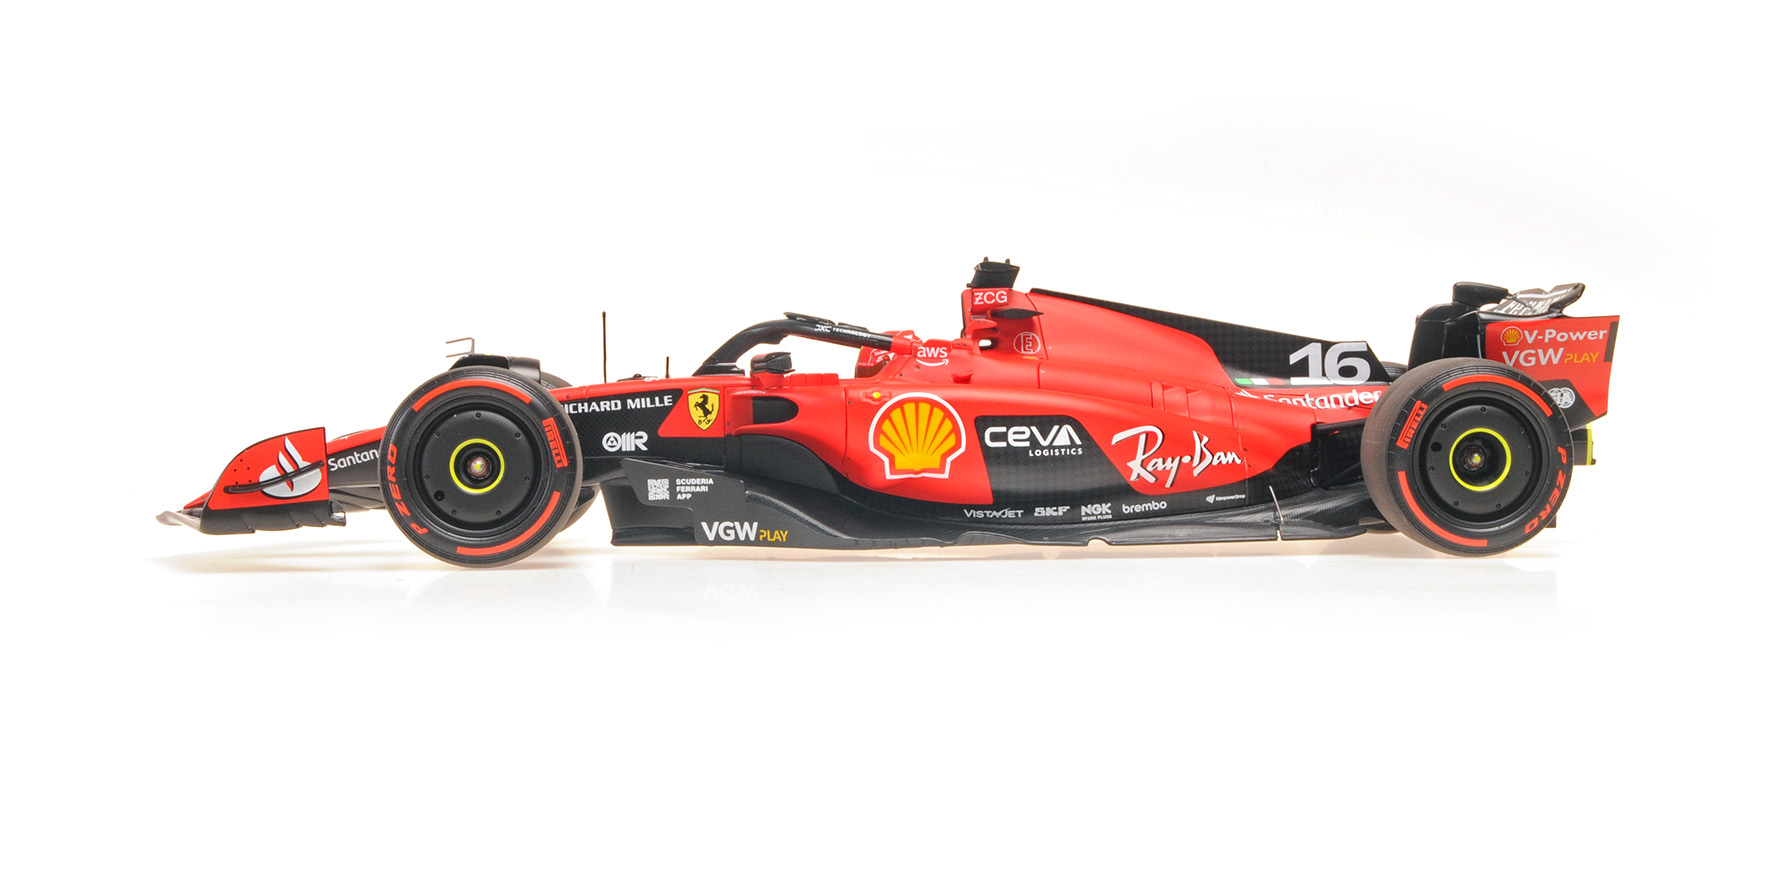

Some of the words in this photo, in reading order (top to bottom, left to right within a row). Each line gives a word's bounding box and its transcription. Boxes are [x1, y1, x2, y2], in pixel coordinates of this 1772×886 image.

[973, 290, 1008, 305] ZCG
[1524, 329, 1608, 344] V-Power
[917, 346, 948, 358] aws
[1502, 347, 1565, 367] VGW
[1564, 352, 1600, 364] PLAY
[1289, 342, 1371, 386] 16
[626, 395, 673, 410] MILLE
[1396, 400, 1428, 450] PIRELLI
[541, 417, 569, 469] PIRELLI
[327, 449, 379, 472] Santan
[1029, 448, 1083, 457] LOGISTICS
[1557, 446, 1567, 464] P
[386, 443, 411, 517] ZERO
[1081, 503, 1112, 515] NGK
[1122, 501, 1167, 514] brembo
[1525, 470, 1566, 534] ZERO
[1034, 505, 1070, 517] SKF
[410, 522, 429, 535] P
[701, 521, 758, 541] VGW
[758, 530, 789, 542] PLAY
